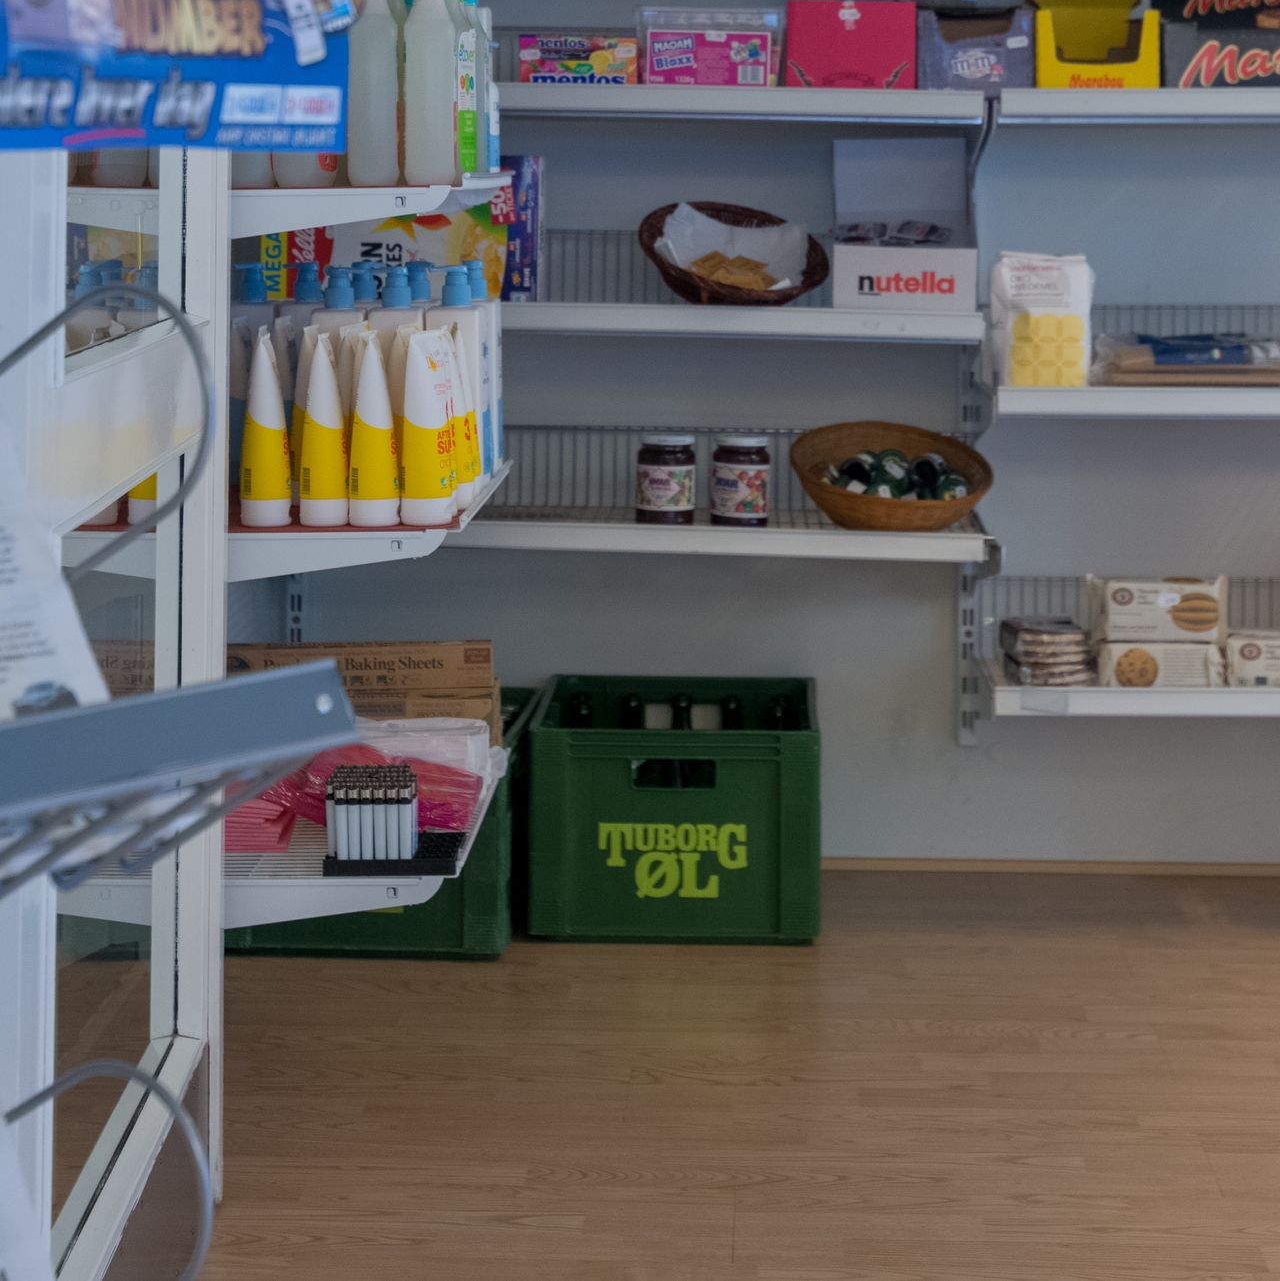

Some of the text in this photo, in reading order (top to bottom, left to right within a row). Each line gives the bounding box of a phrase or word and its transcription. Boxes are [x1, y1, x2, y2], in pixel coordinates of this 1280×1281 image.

[652, 37, 693, 52] MAOAM
[655, 55, 694, 69] Bloxx
[531, 73, 625, 86] mentos
[264, 232, 283, 293] MEGA
[858, 271, 955, 294] nutella
[345, 657, 396, 673] Baking
[399, 657, 444, 670] Sheets
[598, 822, 748, 870] TUBORG
[635, 851, 719, 899] ØL
